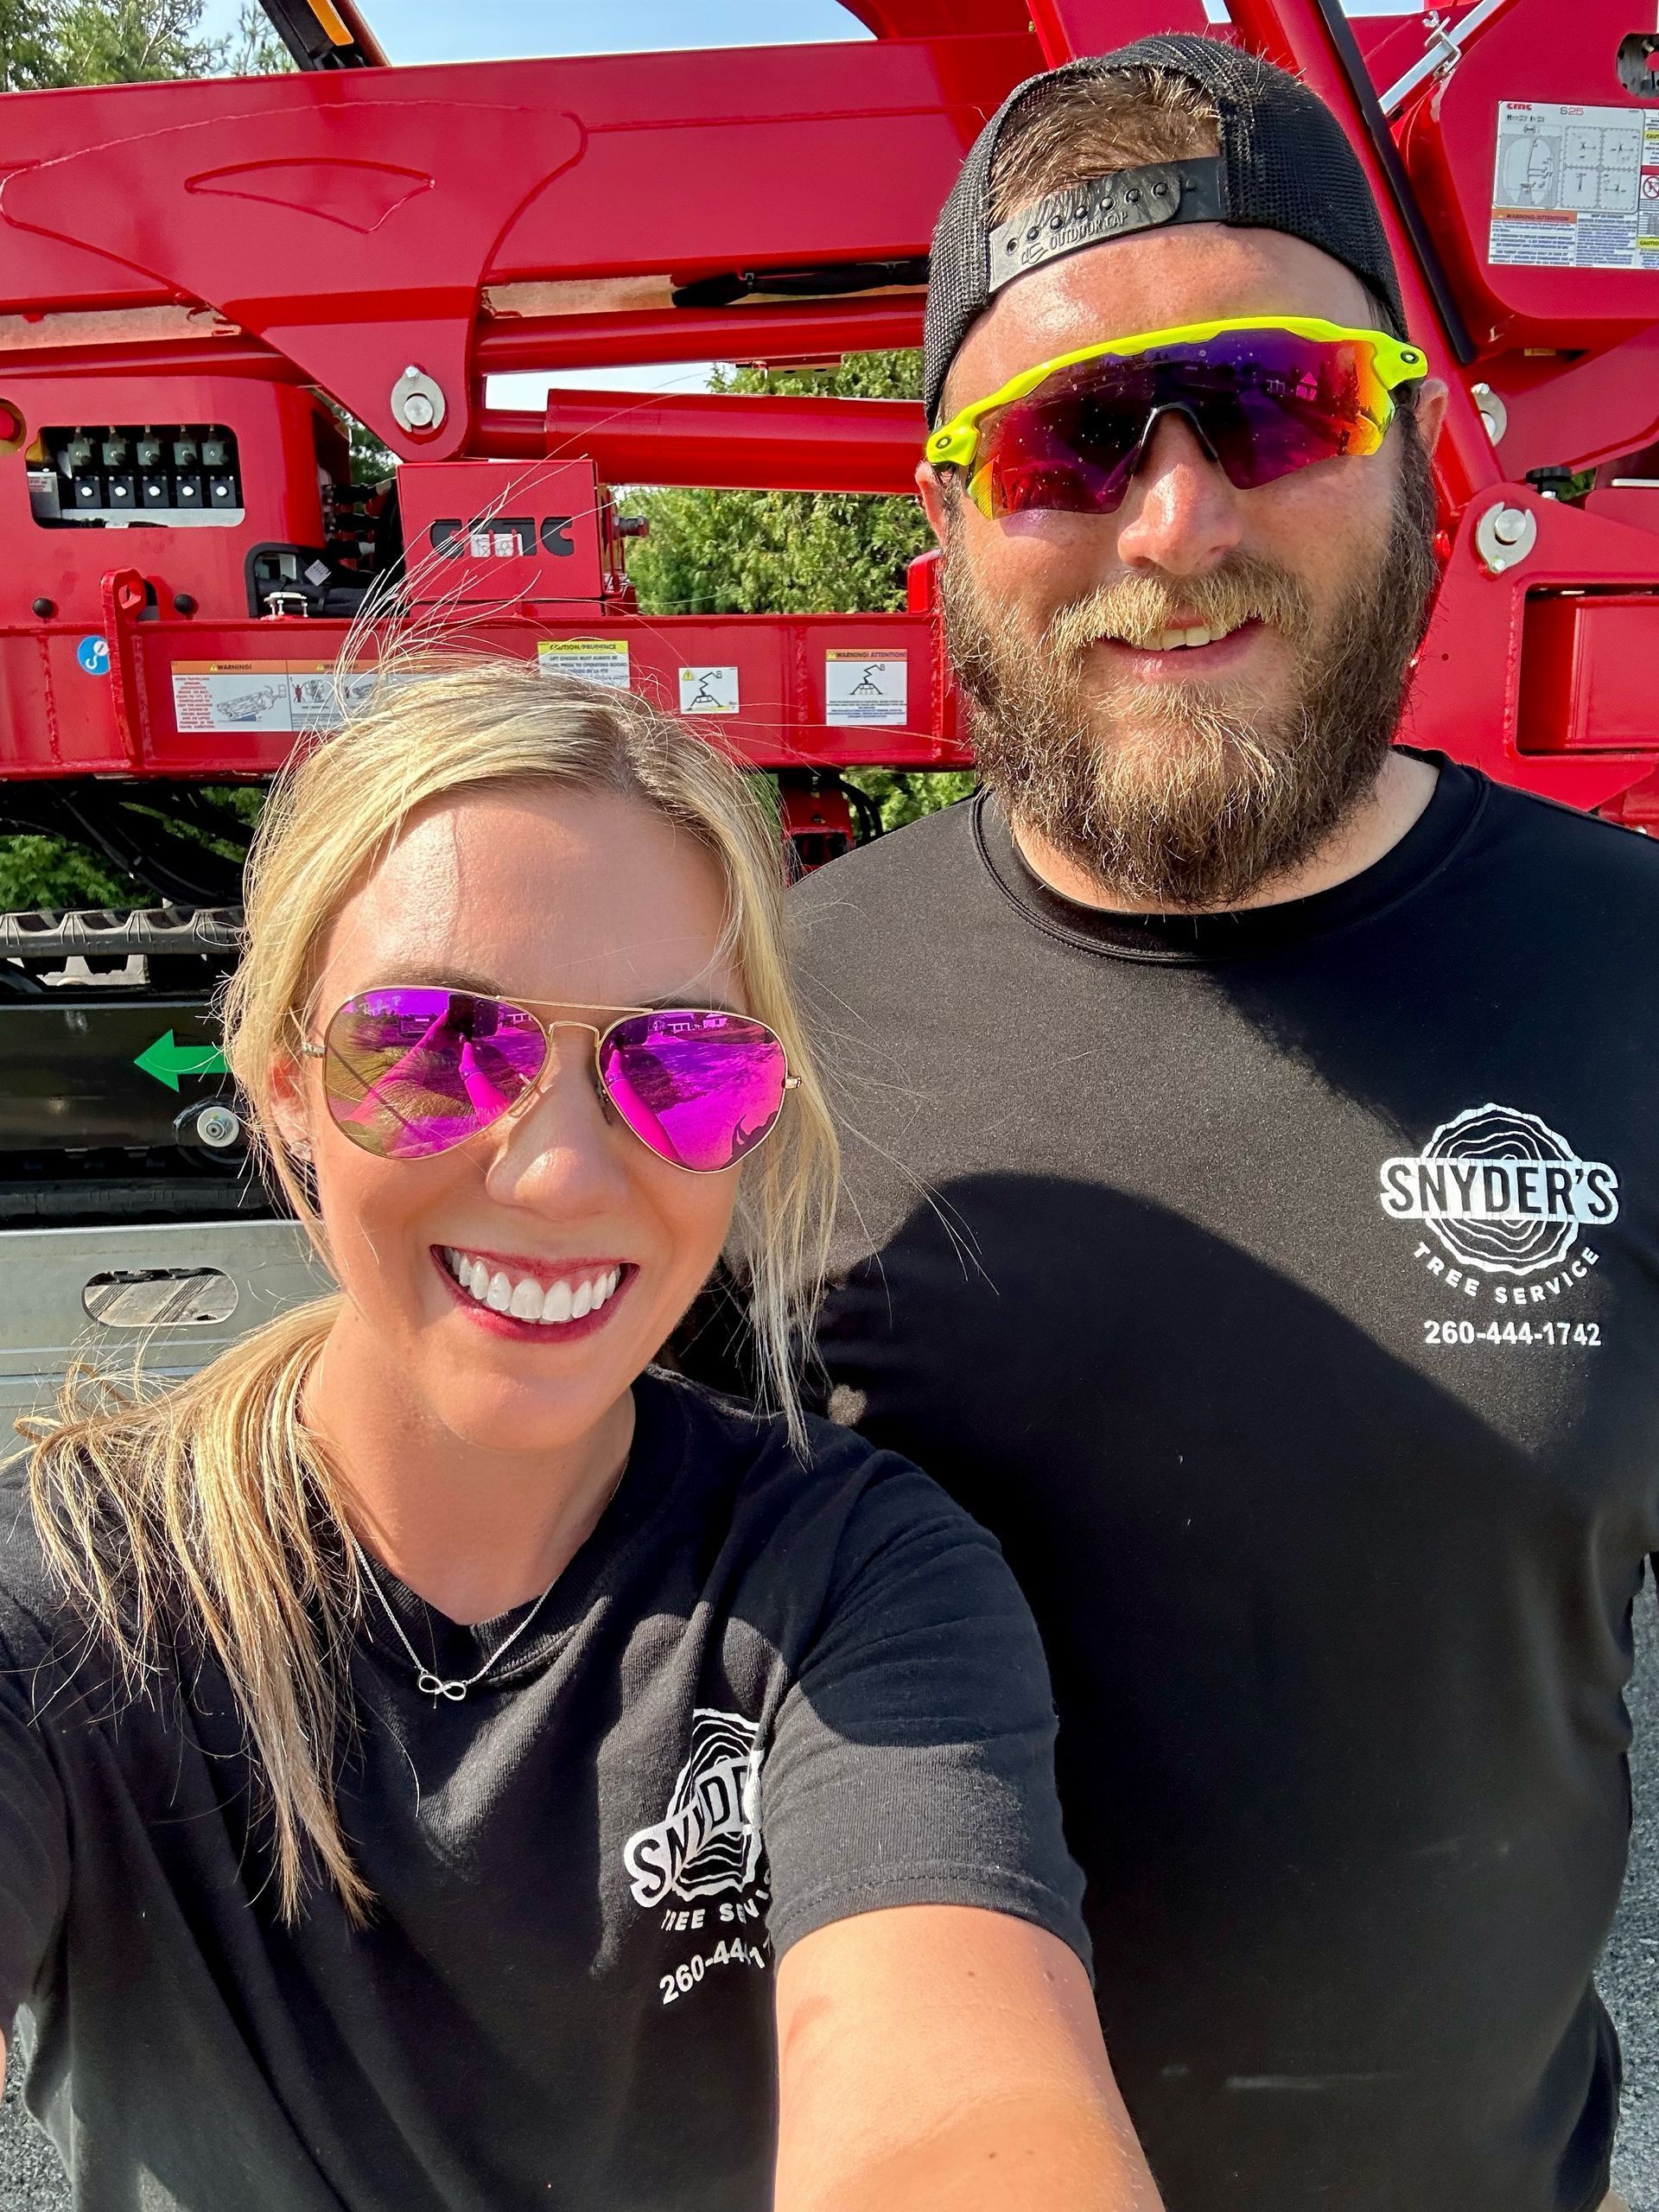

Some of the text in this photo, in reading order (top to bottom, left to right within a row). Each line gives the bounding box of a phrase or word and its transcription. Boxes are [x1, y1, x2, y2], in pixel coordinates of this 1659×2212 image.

[1559, 106, 1584, 116] S25
[1384, 1162, 1614, 1219] SNYDER'S
[1414, 1242, 1599, 1306] TREE SERVICE
[1424, 1319, 1602, 1347] 260-444-1742
